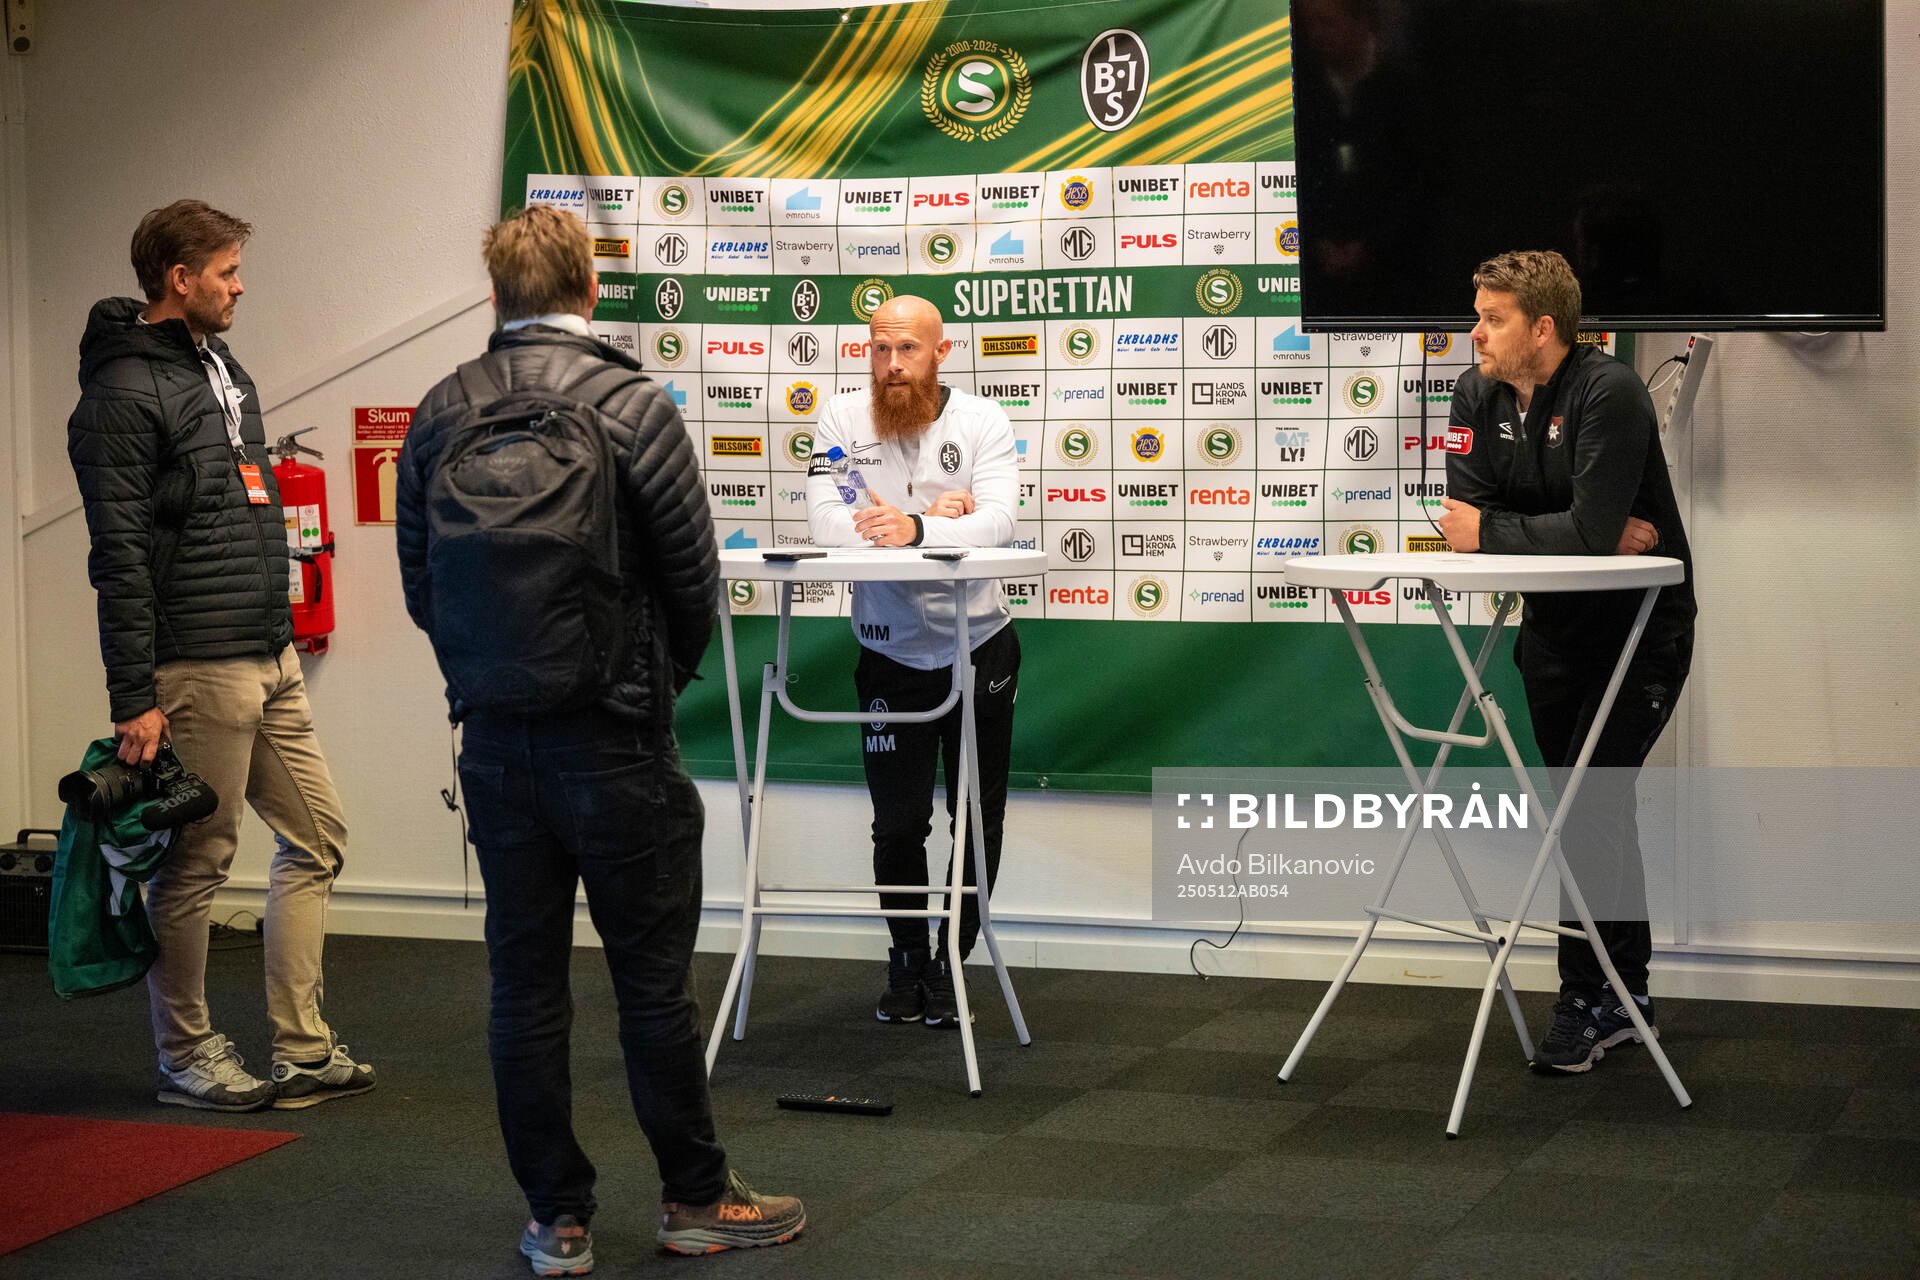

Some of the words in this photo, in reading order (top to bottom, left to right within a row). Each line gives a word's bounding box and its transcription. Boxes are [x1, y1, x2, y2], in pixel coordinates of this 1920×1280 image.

[946, 40, 997, 56] 2000-2025
[981, 185, 1040, 200] UNIBET
[1118, 178, 1180, 193] UNIBET
[1189, 178, 1250, 198] renta
[530, 189, 584, 200] EKBLADHS
[590, 188, 634, 201] UNIBET
[710, 190, 764, 203] UNIBET
[844, 191, 903, 204] UNIBET
[914, 192, 970, 207] PULS
[1120, 233, 1177, 249] PULS
[1187, 229, 1251, 241] Strawberry
[658, 236, 685, 263] MG
[711, 241, 769, 252] EKBLADHS
[775, 240, 834, 254] Strawberry
[858, 242, 900, 258] prenad
[1065, 230, 1092, 257] MG
[1257, 277, 1300, 293] UNIB
[598, 285, 636, 300] NIBET
[705, 287, 771, 302] UNIBET
[954, 275, 1133, 317] SUPERETTAN
[611, 335, 633, 343] LANDS
[1117, 333, 1178, 345] EKBLADHS
[1206, 328, 1233, 357] MG
[707, 341, 764, 355] PULS
[791, 335, 816, 363] MG
[984, 341, 1027, 352] OHLSSONS
[707, 386, 763, 399] UNIBET
[981, 384, 1041, 397] UNIBET
[1117, 382, 1178, 396] UNIBET
[1216, 382, 1245, 390] LANDS
[1261, 381, 1323, 395] UNIBET
[1064, 386, 1104, 402] prenad
[1216, 390, 1247, 398] KRONA
[368, 408, 410, 424] Skum
[713, 441, 753, 452] OHLSSONS
[1347, 429, 1375, 458] MG
[1280, 448, 1305, 462] LY!
[711, 484, 766, 498] UNIBET
[1047, 488, 1107, 502] PULS
[1118, 484, 1178, 497] UNIBET
[1190, 486, 1251, 505] renta
[1261, 484, 1319, 497] UNIBET
[1344, 487, 1392, 504] prenad
[1064, 531, 1092, 559] MG
[1145, 534, 1174, 542] LANDS
[1145, 541, 1176, 549] KRONA
[1189, 535, 1249, 548] Strawberry
[1257, 537, 1320, 549] EKBLADHS
[1145, 549, 1165, 557] HEM
[806, 589, 835, 597] KRONA
[806, 596, 824, 604] HEM
[1050, 585, 1109, 605] renta
[1201, 590, 1244, 605] prenad
[1257, 586, 1318, 600] UNIBET
[860, 623, 890, 641] MM
[866, 734, 896, 753] MM
[718, 1204, 764, 1221] HOKA
